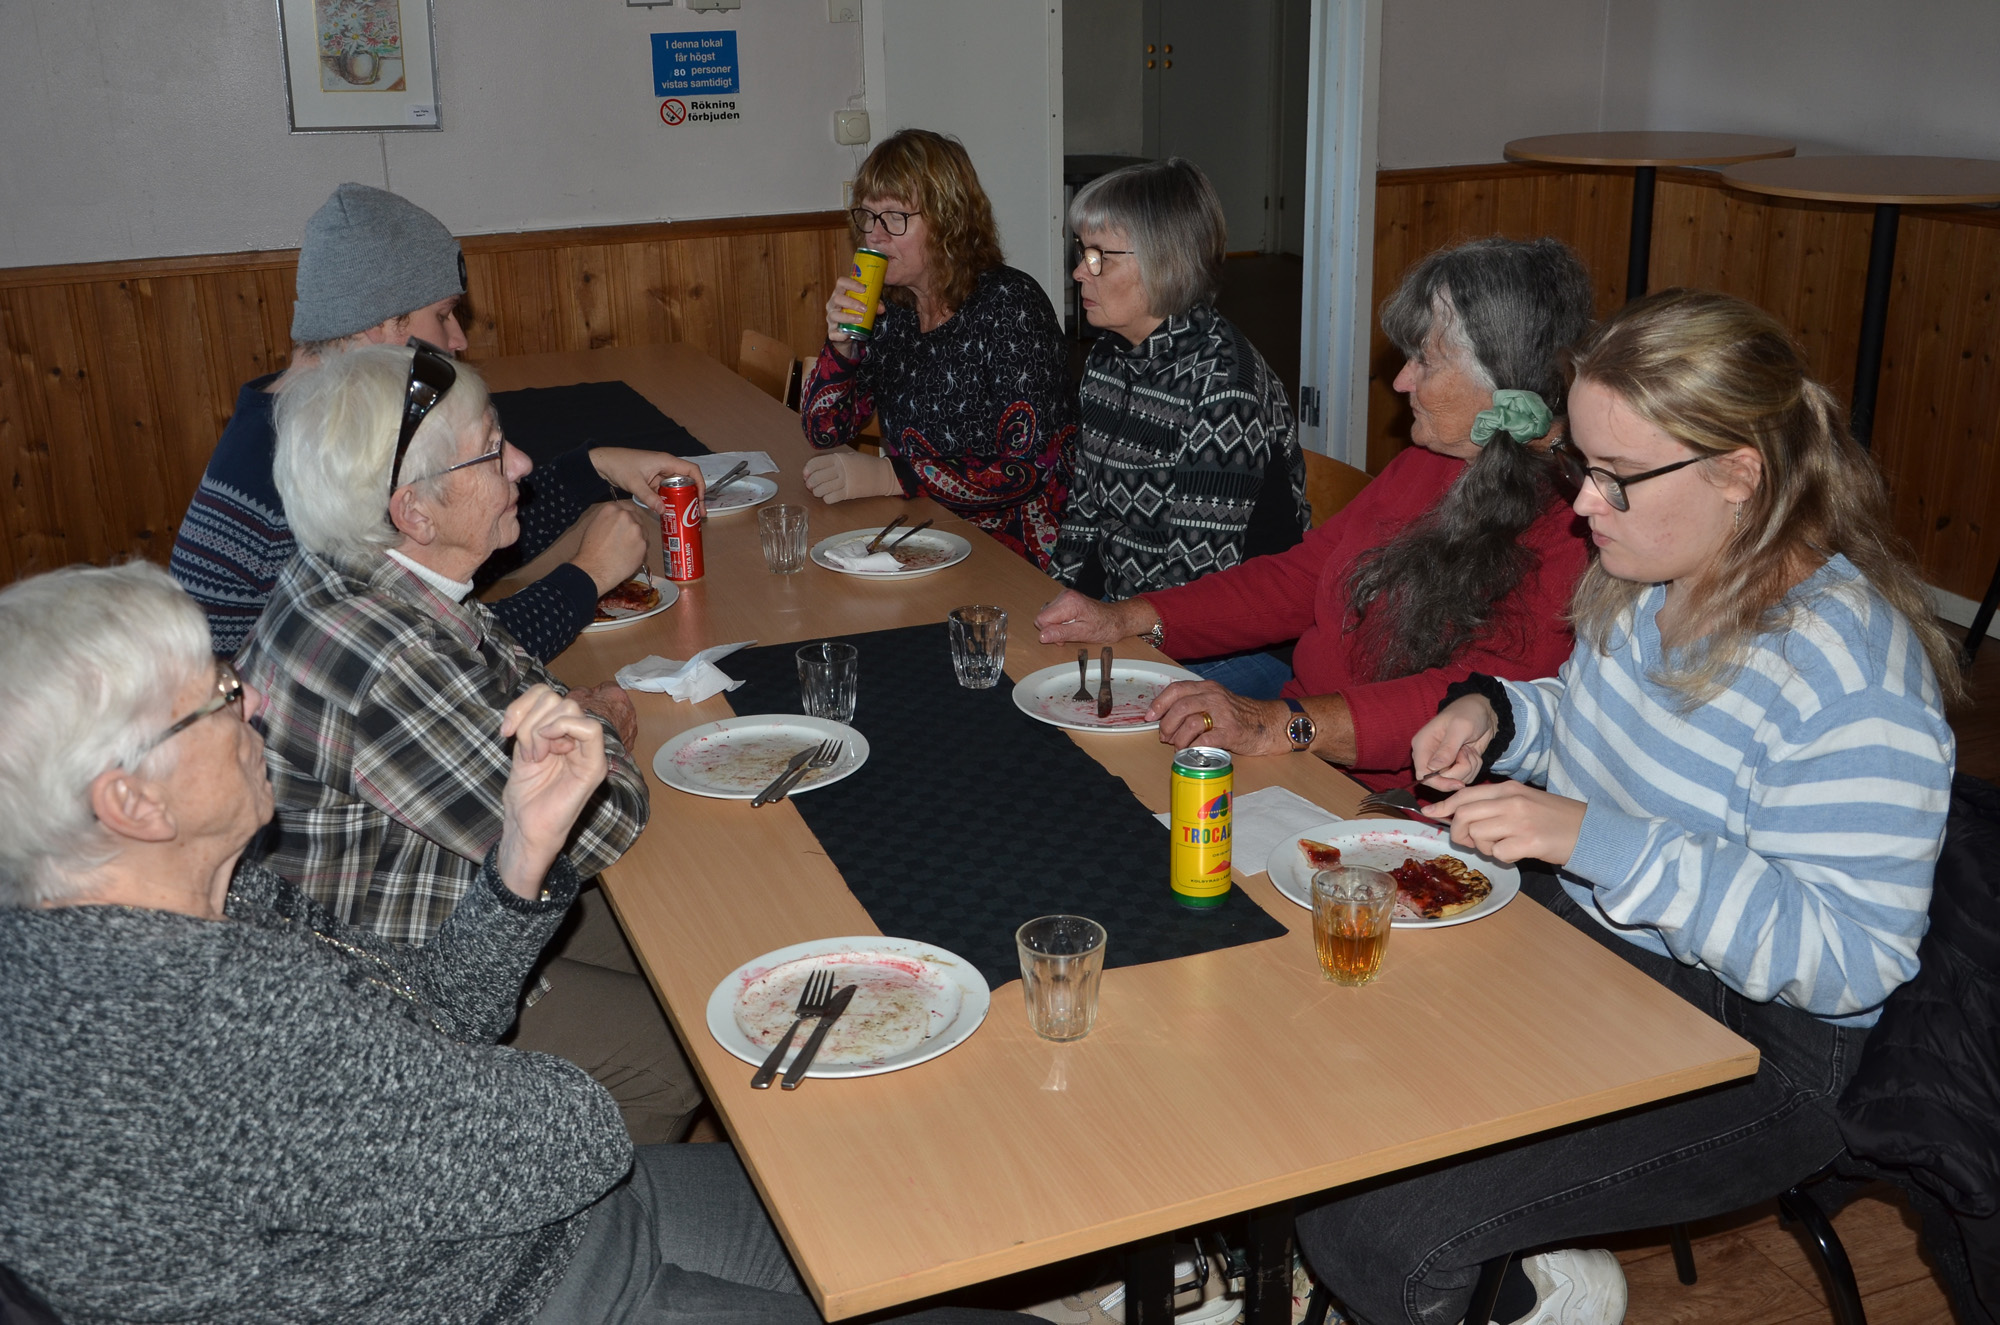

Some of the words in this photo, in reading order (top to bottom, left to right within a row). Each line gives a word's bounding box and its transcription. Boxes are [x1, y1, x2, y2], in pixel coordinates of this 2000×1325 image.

[671, 39, 699, 49] denna
[701, 38, 723, 48] lokal
[675, 52, 688, 62] får
[690, 52, 716, 63] högst
[673, 68, 686, 76] 80
[691, 65, 731, 76] personer
[661, 80, 688, 89] vistas
[690, 77, 732, 88] samtidigt
[691, 100, 736, 110] Rökning
[688, 111, 740, 122] förbjuden
